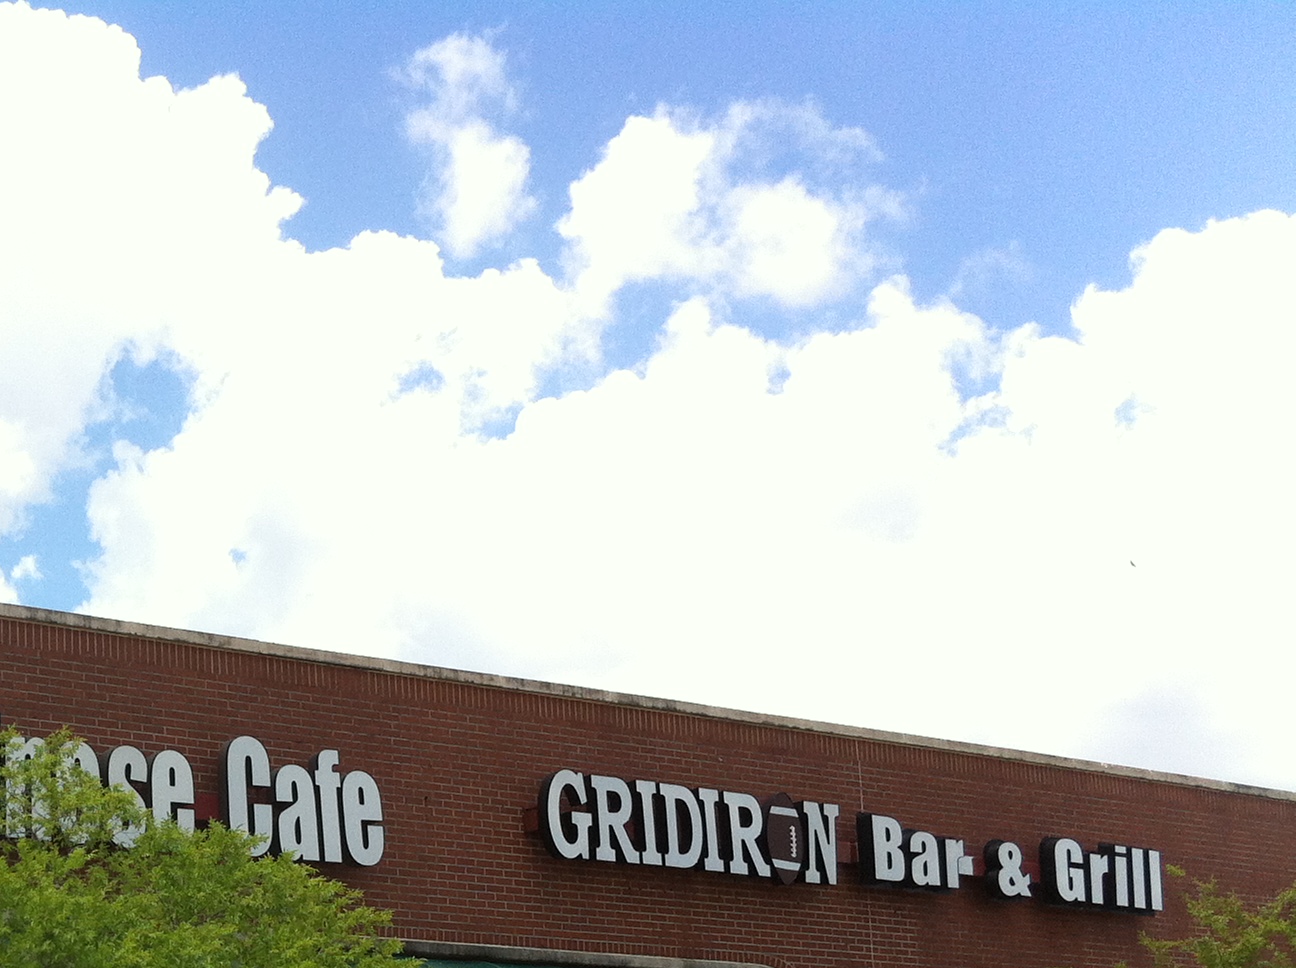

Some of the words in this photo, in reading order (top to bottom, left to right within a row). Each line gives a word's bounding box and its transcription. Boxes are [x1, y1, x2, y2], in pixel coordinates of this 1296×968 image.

[226, 735, 385, 867] Cafe
[871, 814, 975, 890] Bar
[996, 841, 1032, 898] &
[1054, 837, 1164, 912] Grill
